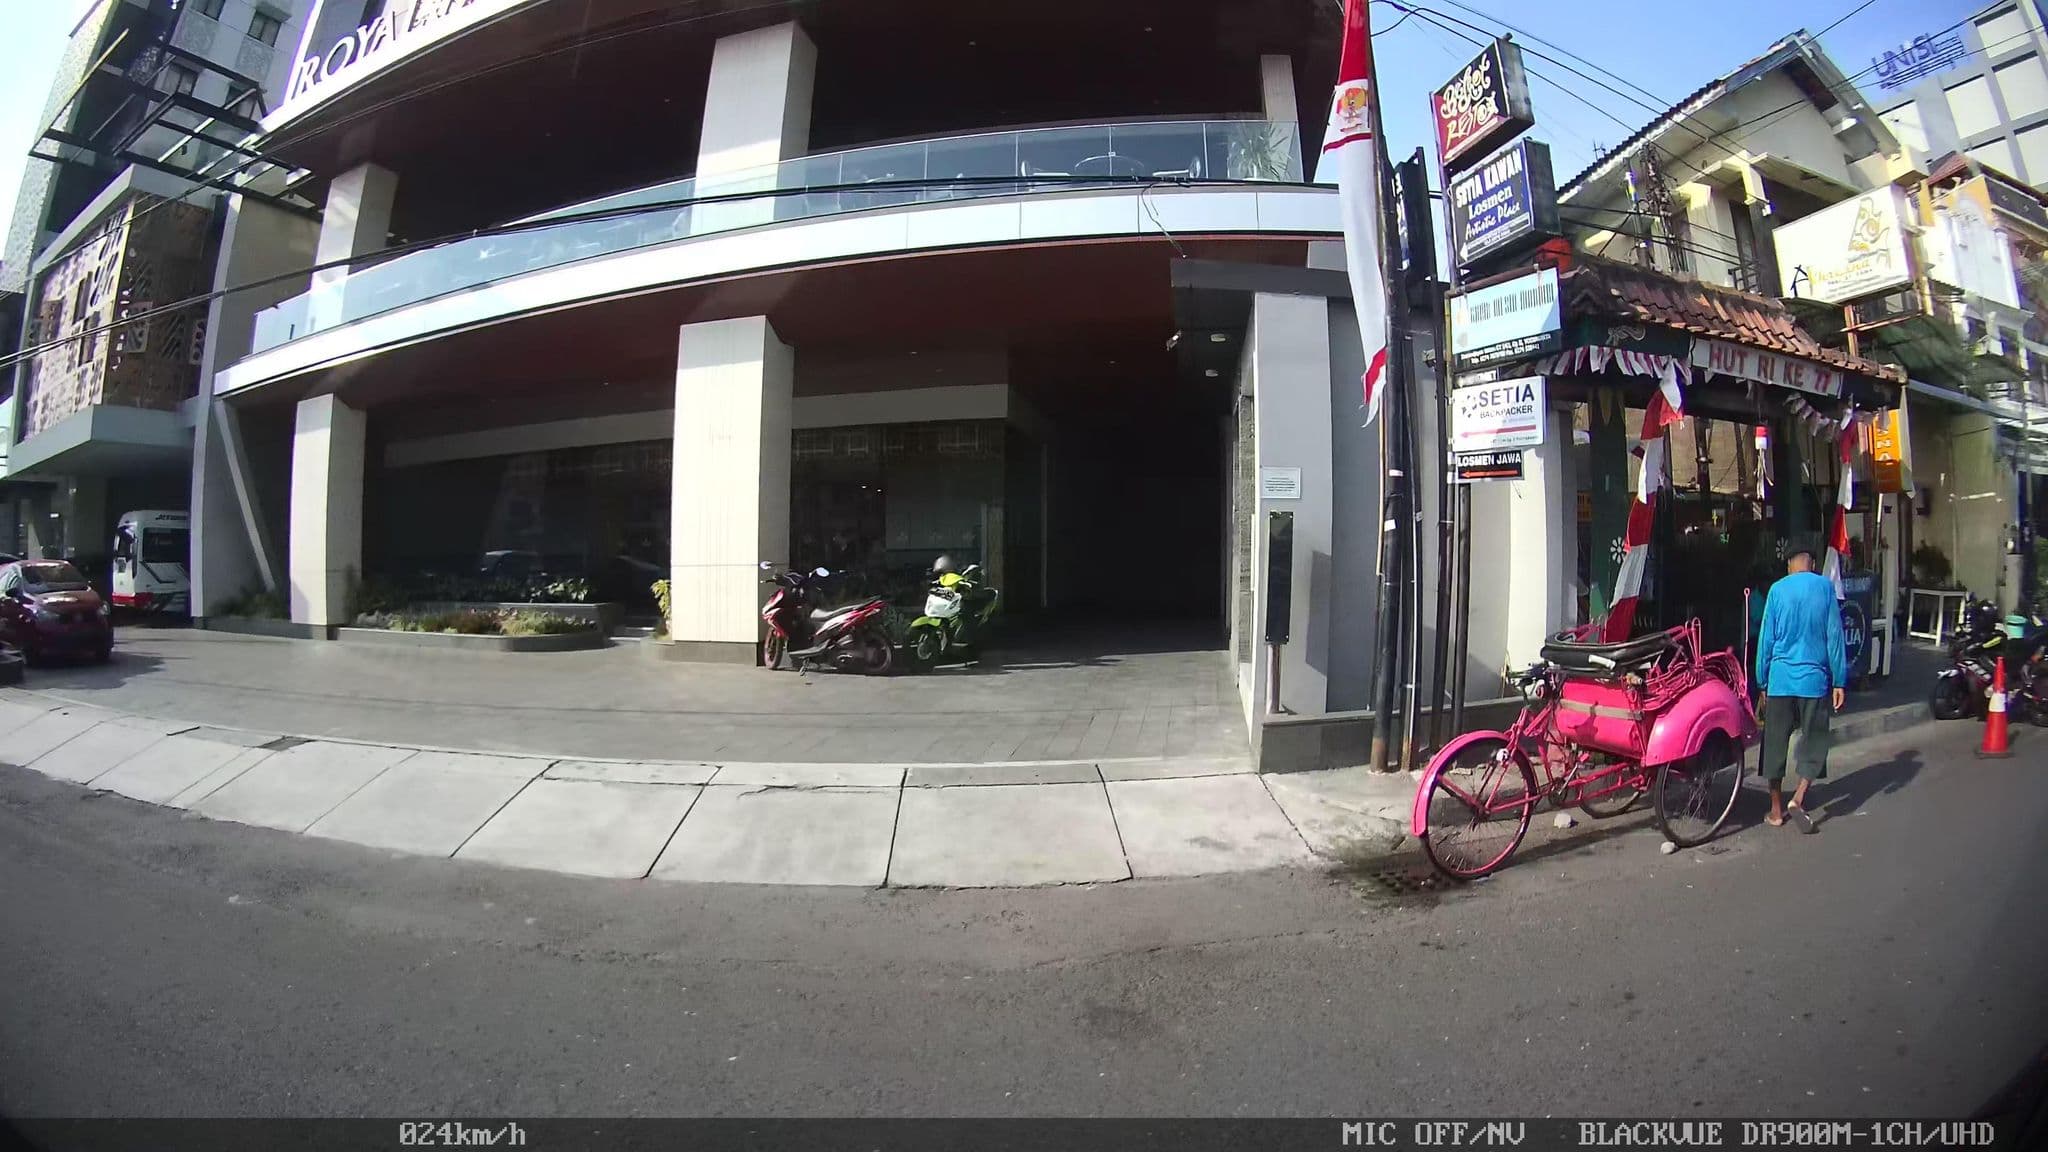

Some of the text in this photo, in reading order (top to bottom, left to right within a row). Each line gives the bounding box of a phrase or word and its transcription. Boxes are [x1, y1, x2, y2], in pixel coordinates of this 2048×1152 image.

[1484, 148, 1523, 191] KAWAN
[1468, 186, 1513, 220] Losmen
[1709, 343, 1748, 375] HUT
[1757, 354, 1776, 381] RI
[1783, 360, 1805, 387] KE
[1479, 384, 1535, 407] SETIA
[1480, 405, 1533, 419] BACKPACKER
[1457, 452, 1522, 467] LOSMEN JAWA
